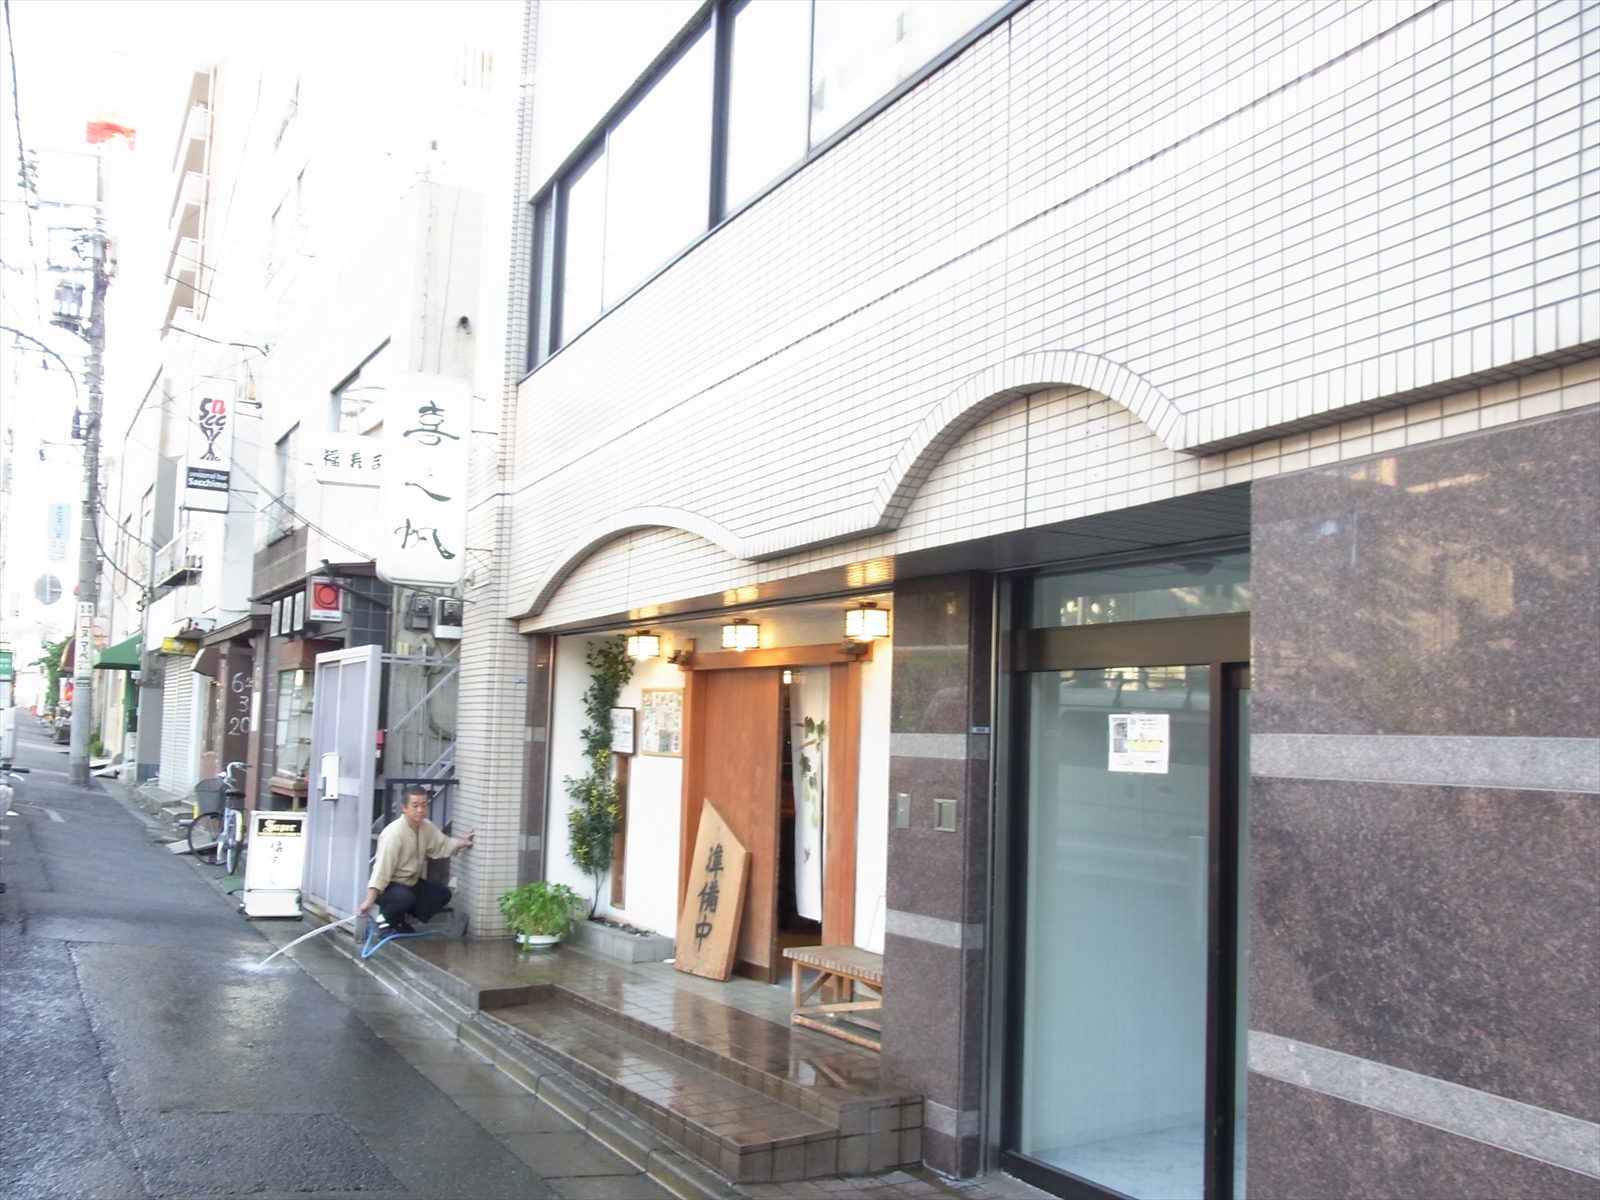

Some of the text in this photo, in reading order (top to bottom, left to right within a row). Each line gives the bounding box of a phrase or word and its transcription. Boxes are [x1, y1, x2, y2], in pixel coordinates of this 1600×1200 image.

[188, 477, 228, 489] Sacchimo
[54, 506, 64, 539] KUMON
[79, 629, 89, 660] ヌマベ
[694, 842, 724, 953] 準備中
